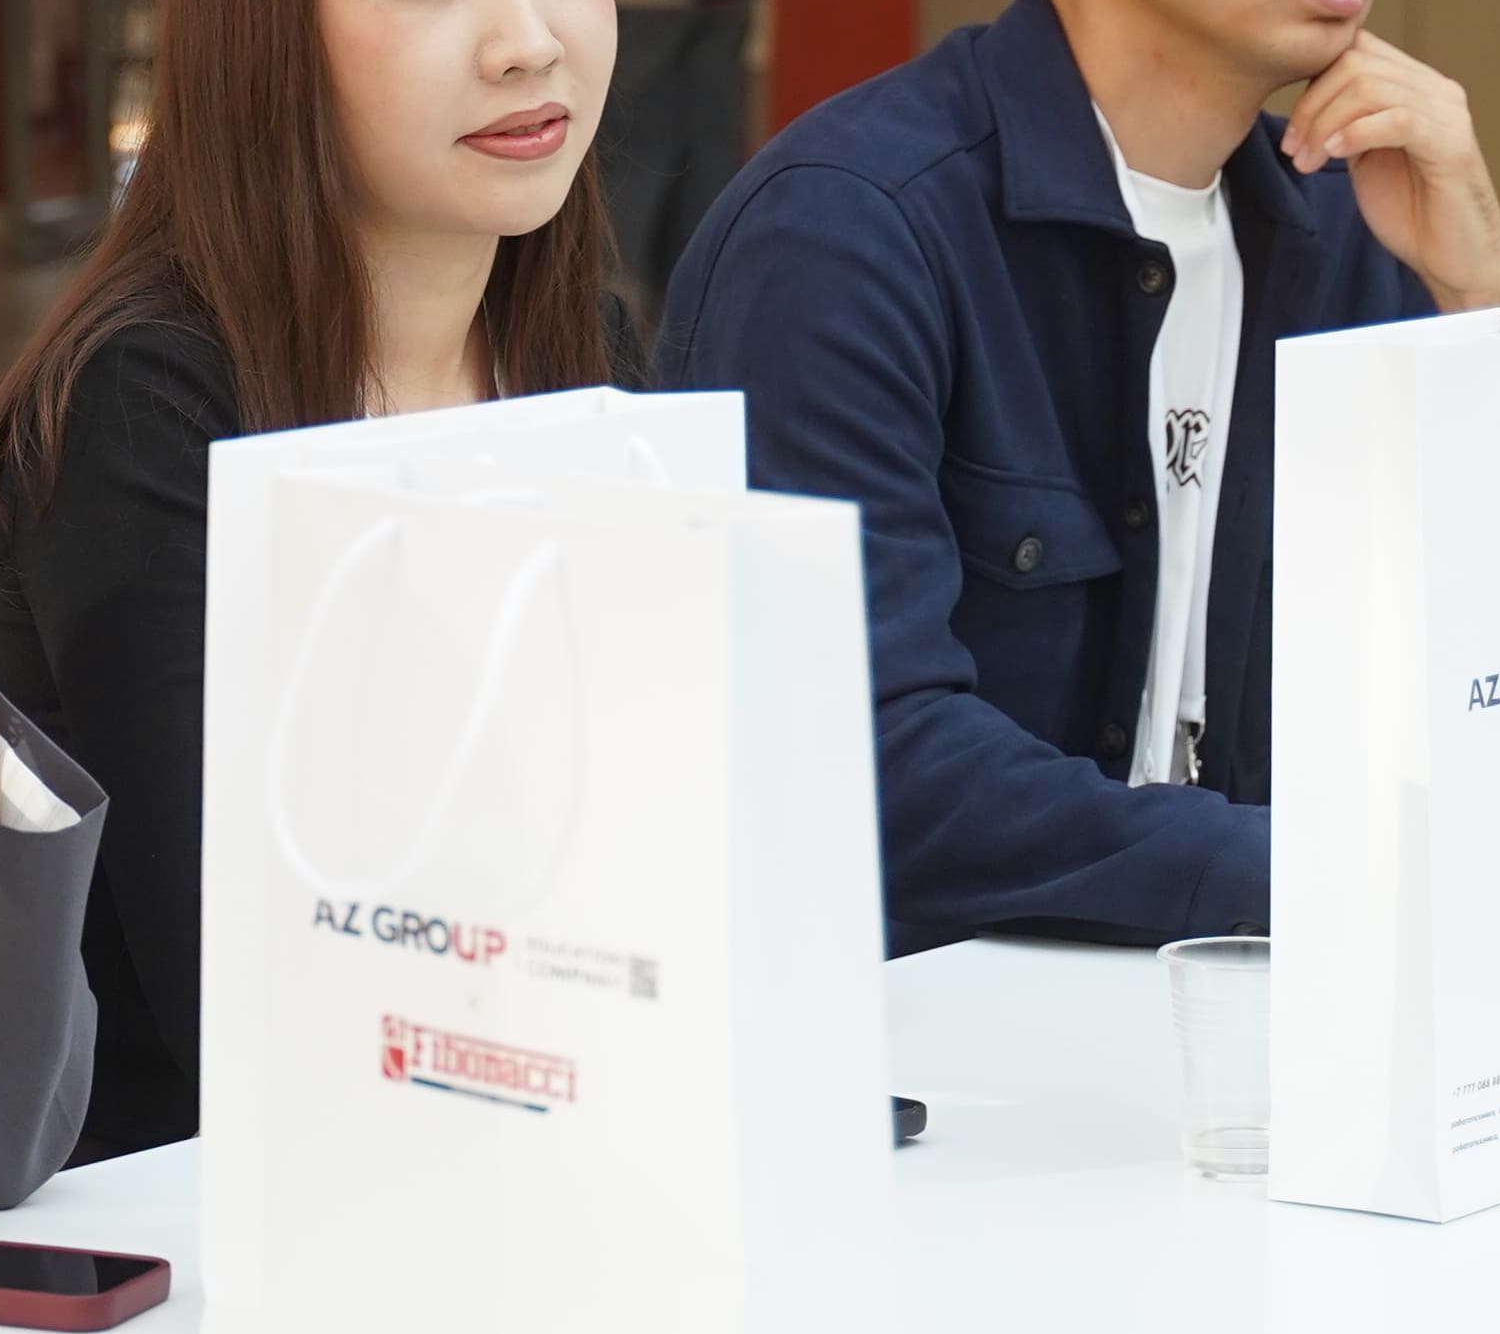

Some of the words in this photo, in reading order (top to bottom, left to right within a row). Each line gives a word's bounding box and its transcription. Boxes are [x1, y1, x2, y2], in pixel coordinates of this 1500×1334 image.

[1468, 673, 1500, 712] AZ
[313, 898, 362, 937] AZ
[371, 905, 508, 965] GROUP
[411, 1023, 577, 1103] Fibonacci
